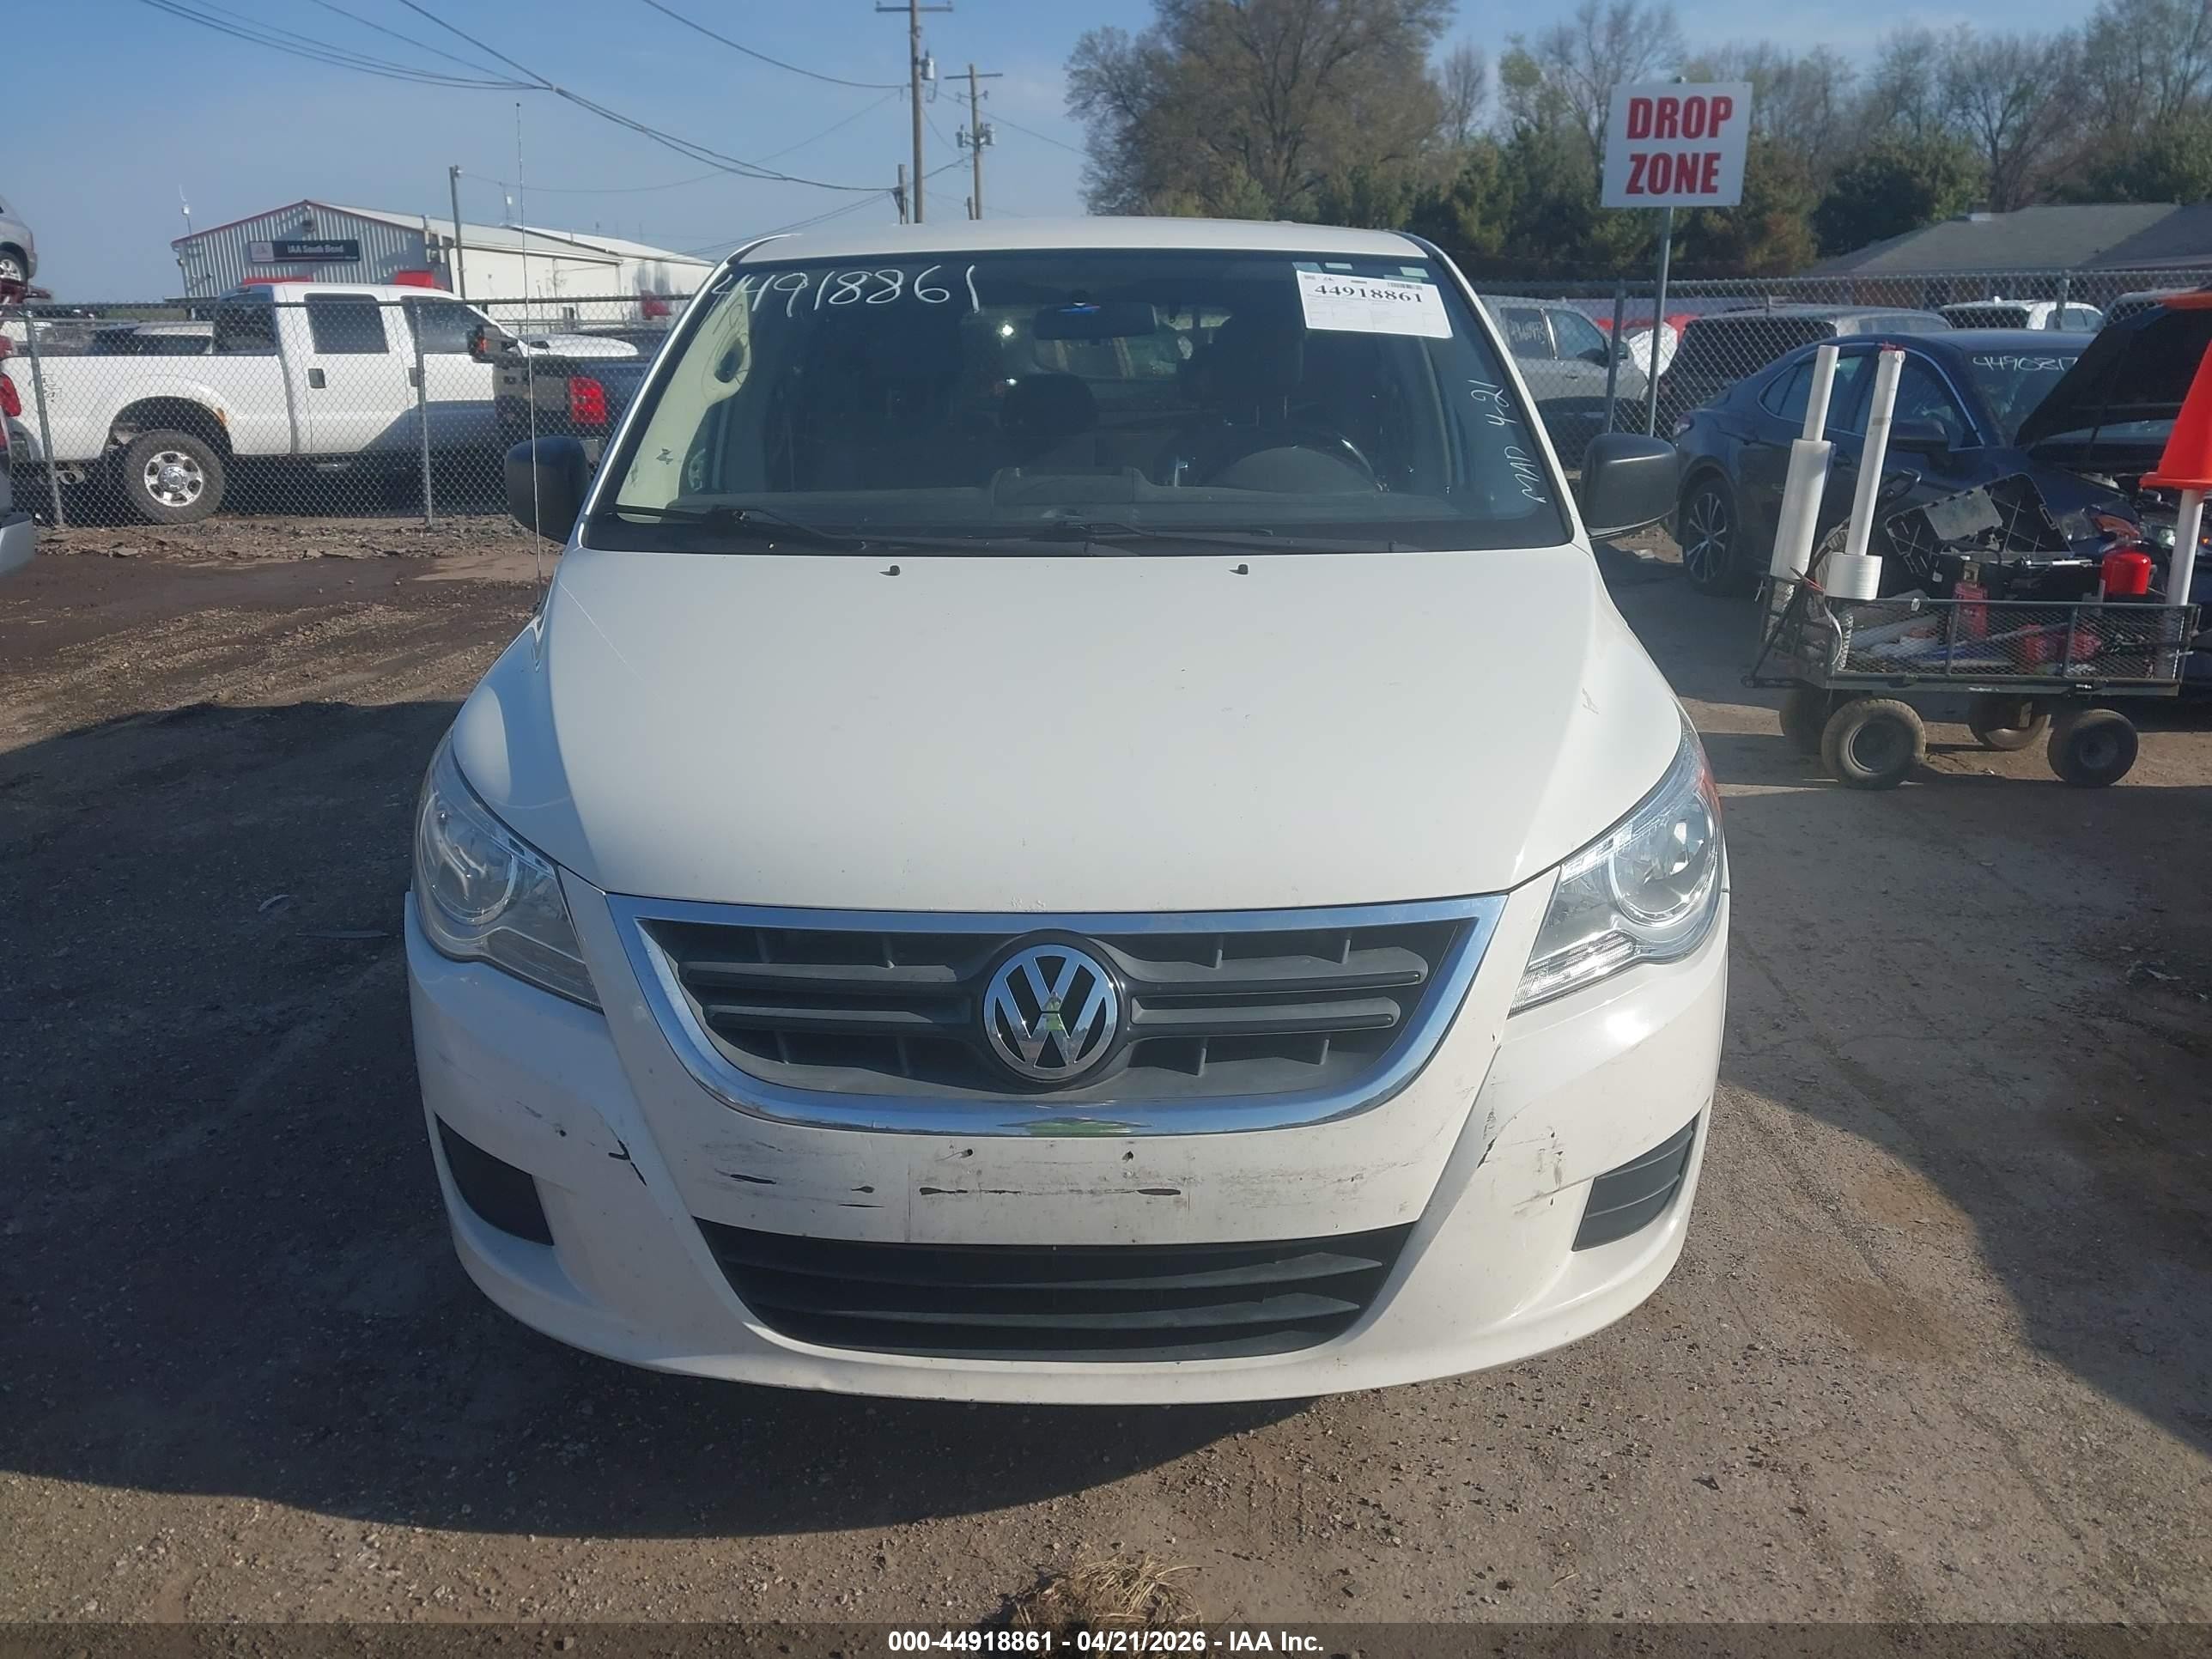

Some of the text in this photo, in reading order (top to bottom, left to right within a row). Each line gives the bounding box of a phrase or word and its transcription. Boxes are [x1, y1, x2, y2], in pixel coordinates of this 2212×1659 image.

[1626, 96, 1733, 139] DROP
[1626, 152, 1722, 195] ZONE
[711, 264, 980, 318] 44918861
[1314, 284, 1424, 303] 44918861
